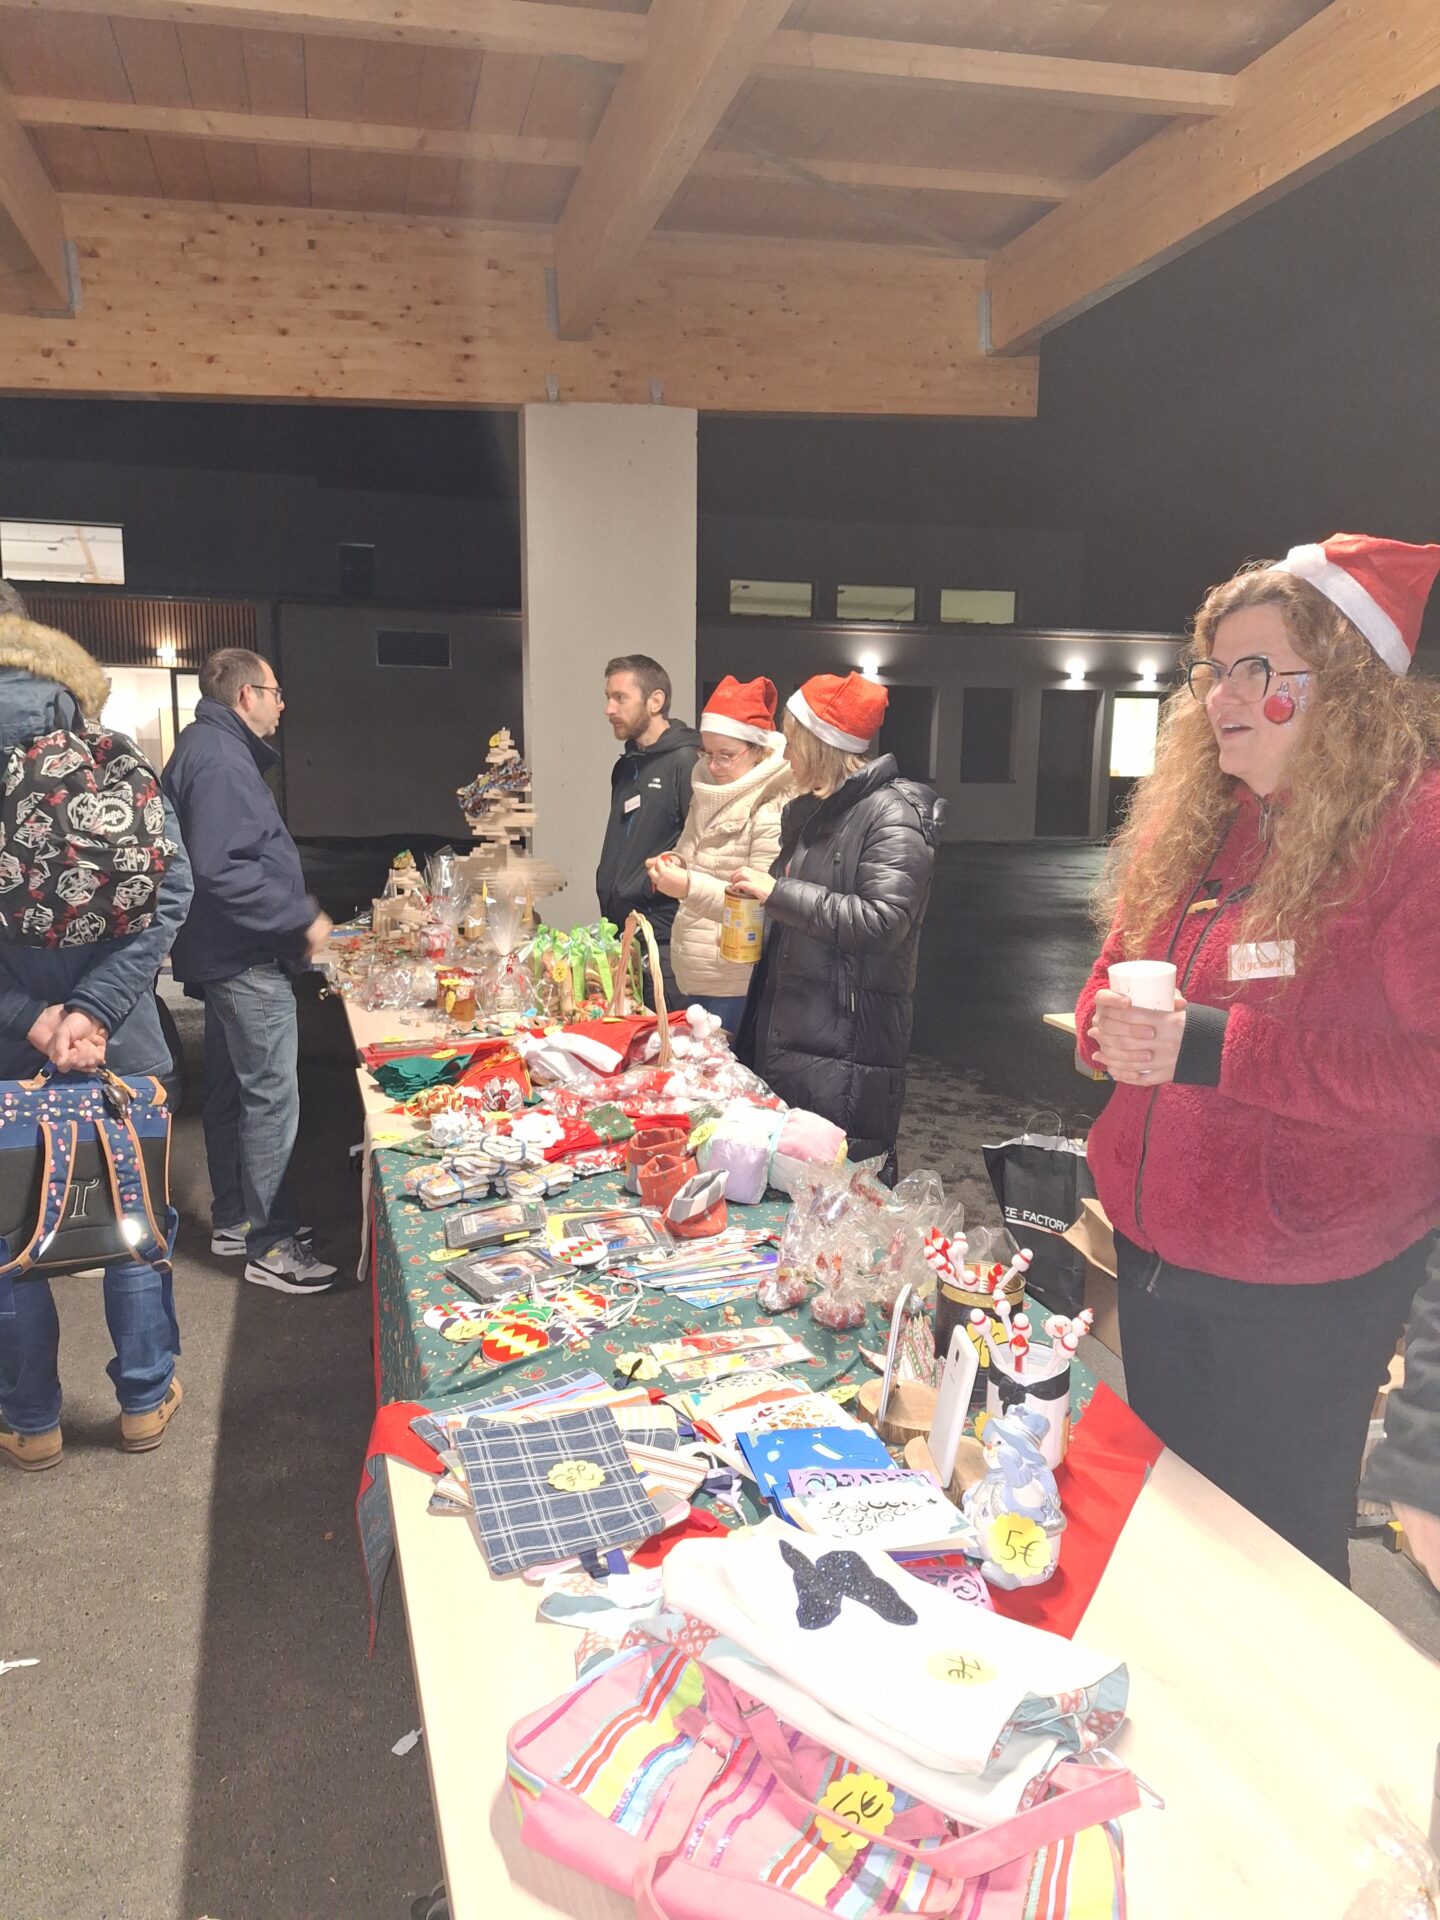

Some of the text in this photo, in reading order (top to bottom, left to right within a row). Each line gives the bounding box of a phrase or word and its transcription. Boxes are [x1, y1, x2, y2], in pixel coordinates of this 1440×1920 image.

[1022, 1210, 1069, 1232] FACTORY
[1000, 1529, 1041, 1569] 5€
[946, 1656, 981, 1680] 7€
